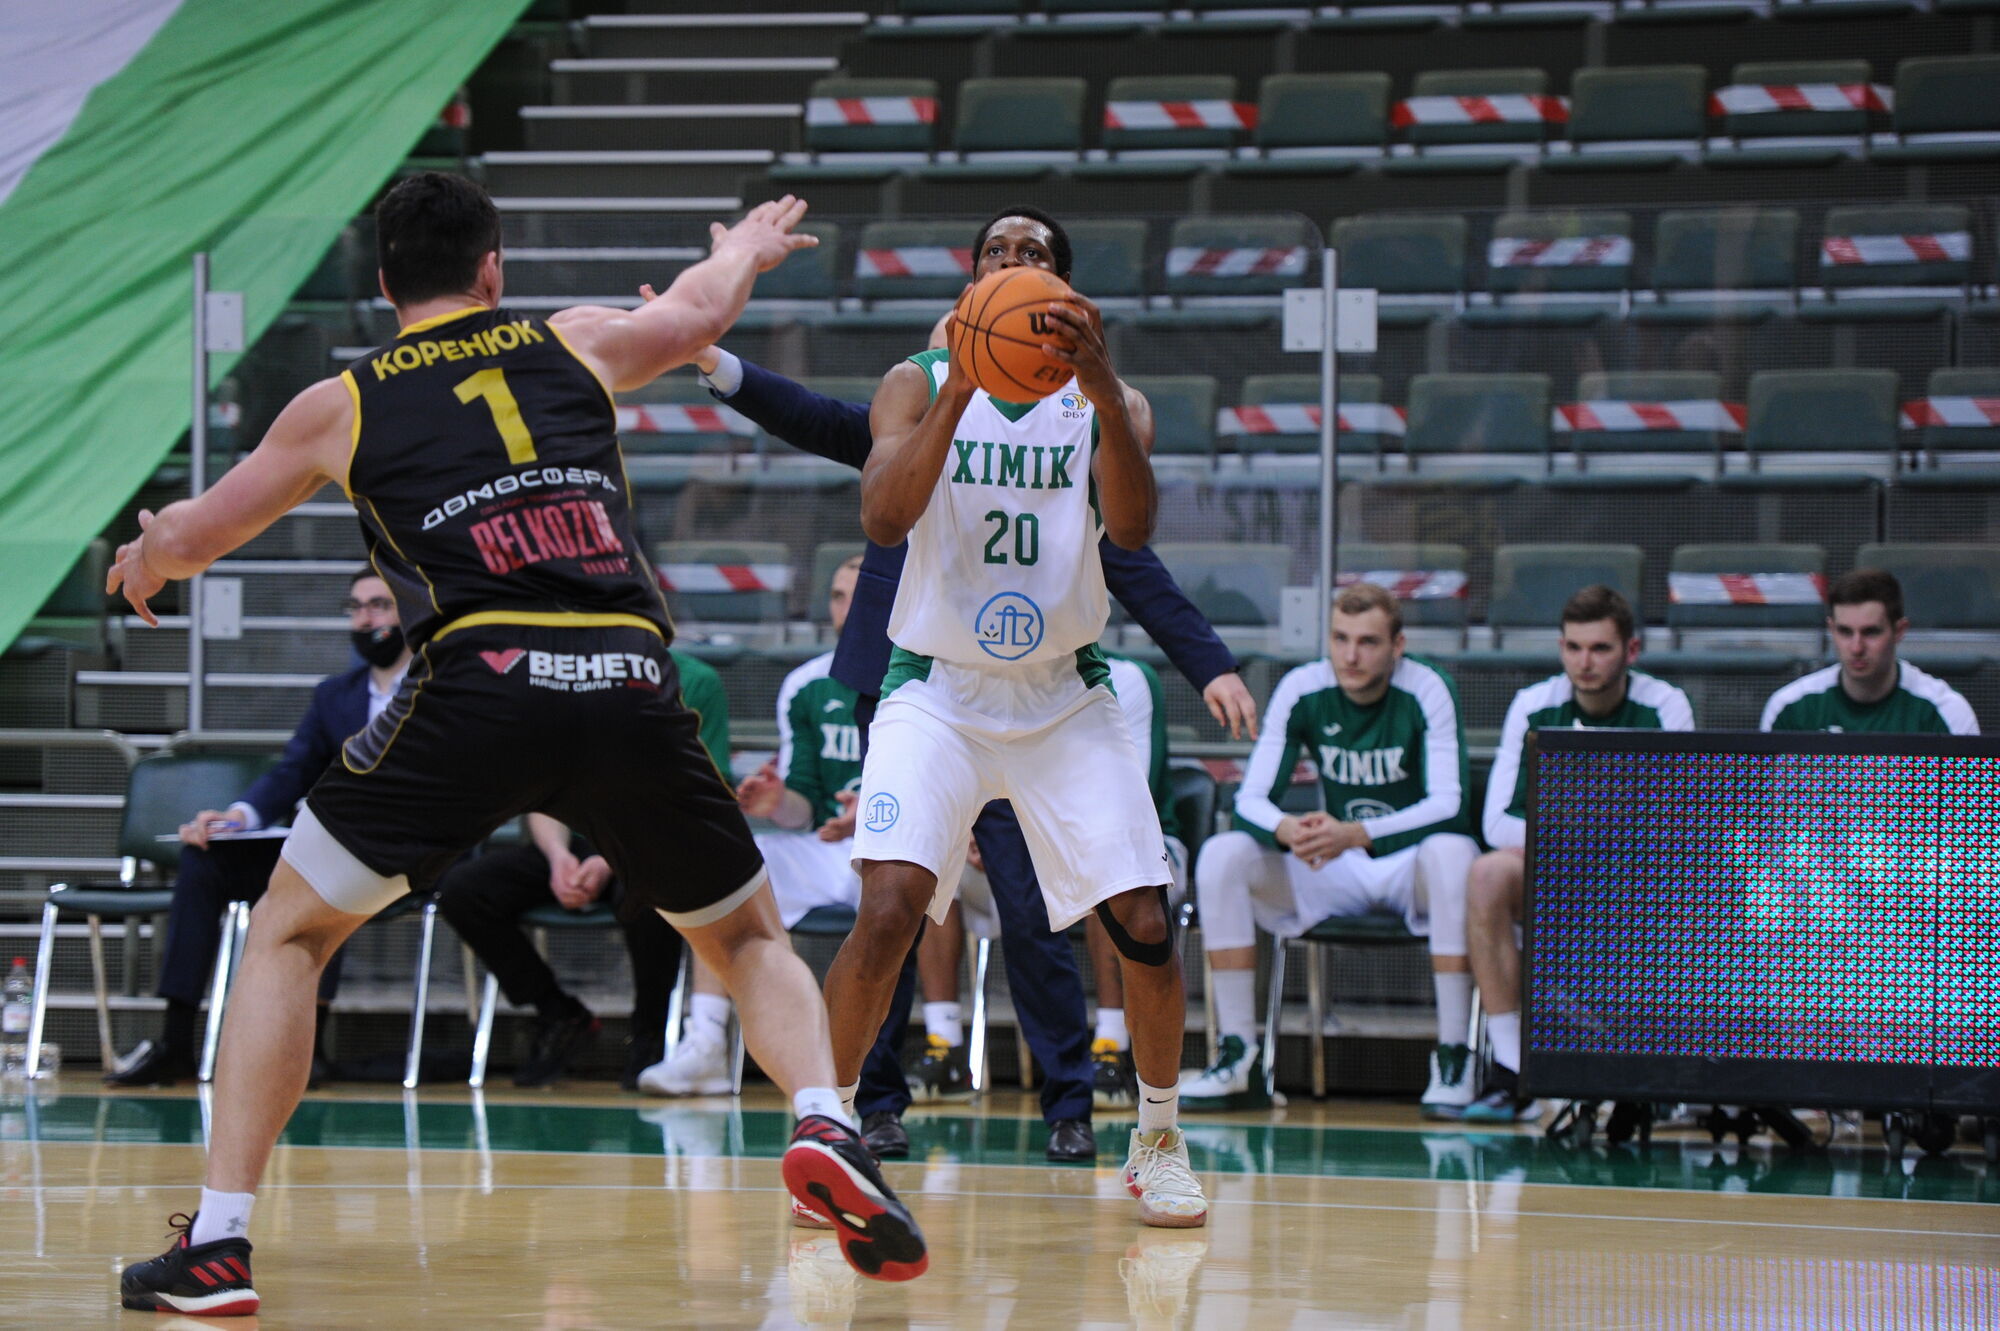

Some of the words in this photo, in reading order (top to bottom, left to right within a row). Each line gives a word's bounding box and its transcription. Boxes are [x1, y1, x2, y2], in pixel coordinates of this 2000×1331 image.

[371, 320, 544, 381] КОРЕНЮК
[452, 367, 538, 465] 1
[1062, 410, 1086, 419] ФБУ
[422, 467, 617, 531] ДОМОСФЕРА
[983, 510, 1039, 566] 20
[528, 650, 662, 685] ВЕНЕТО
